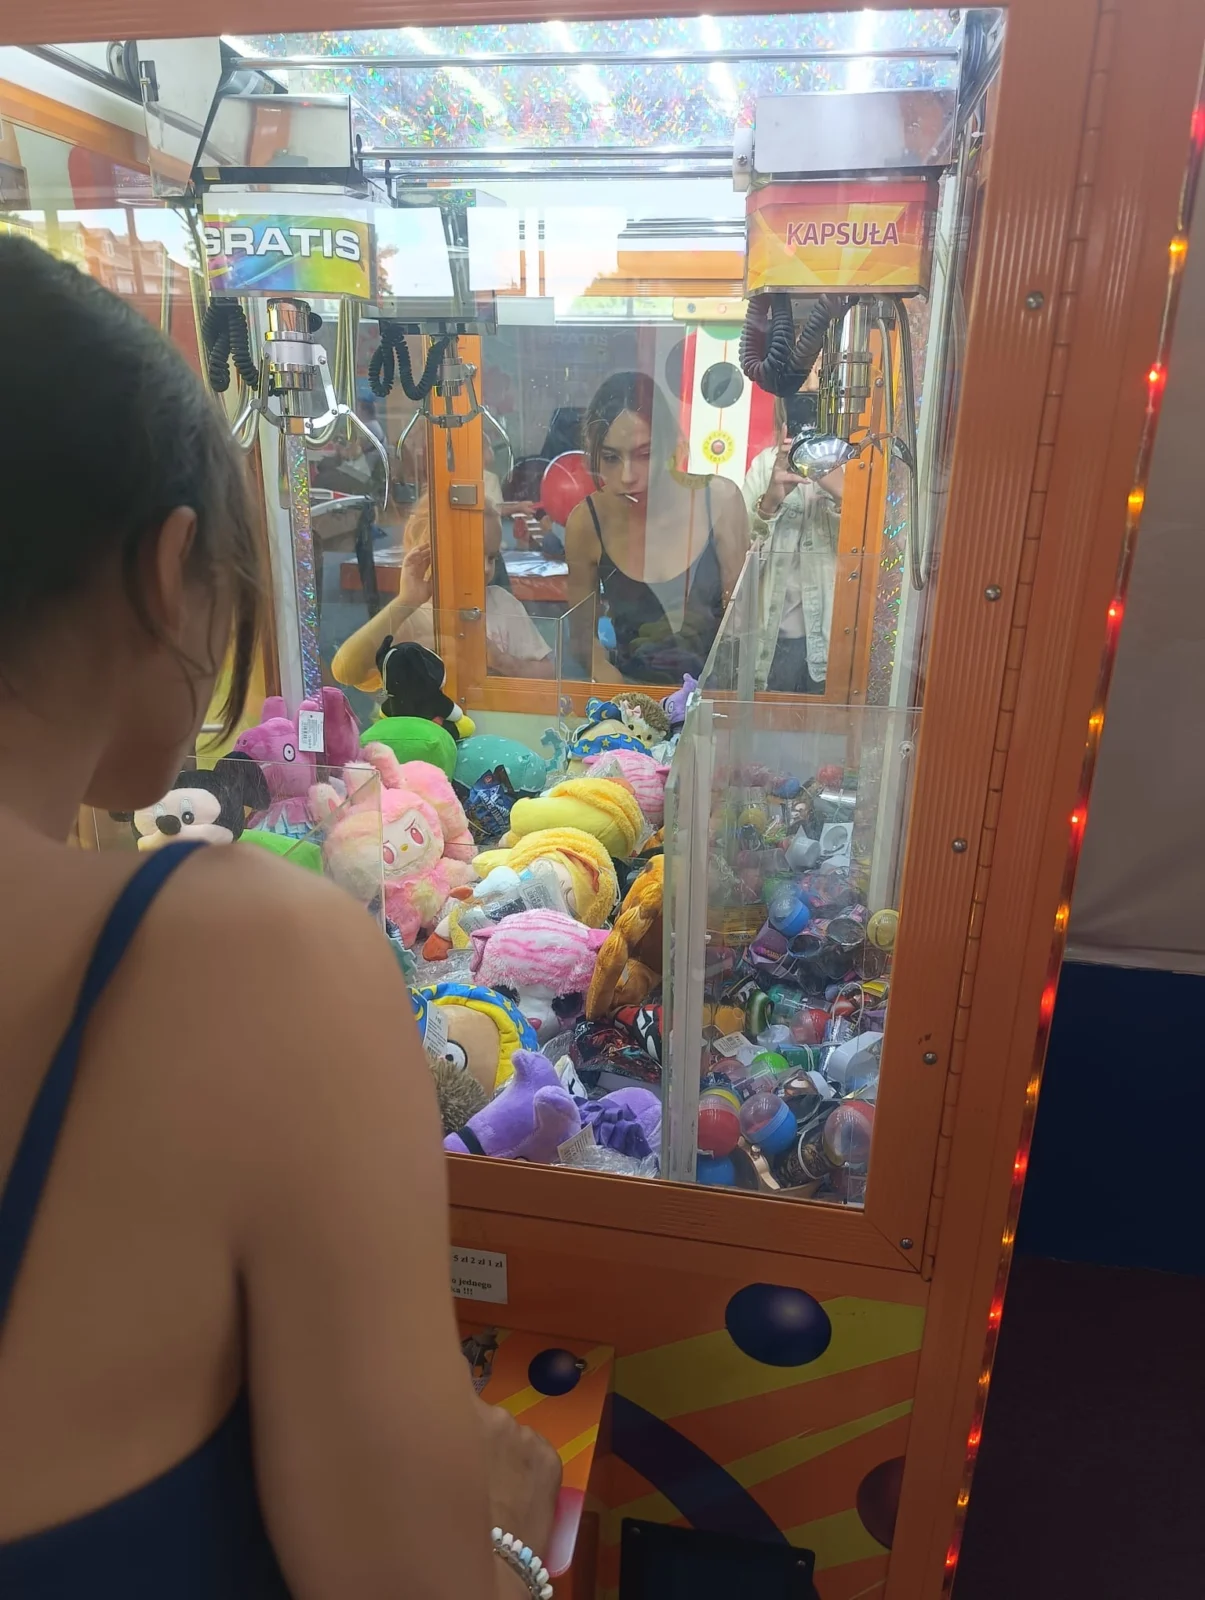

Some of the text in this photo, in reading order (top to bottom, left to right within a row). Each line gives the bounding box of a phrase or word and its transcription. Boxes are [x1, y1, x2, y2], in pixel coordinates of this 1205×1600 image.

[786, 222, 899, 247] KAPSUŁA
[203, 226, 361, 262] GRATIS
[453, 1254, 459, 1262] 5
[458, 1278, 492, 1289] jednego
[463, 1287, 473, 1295] !!!
